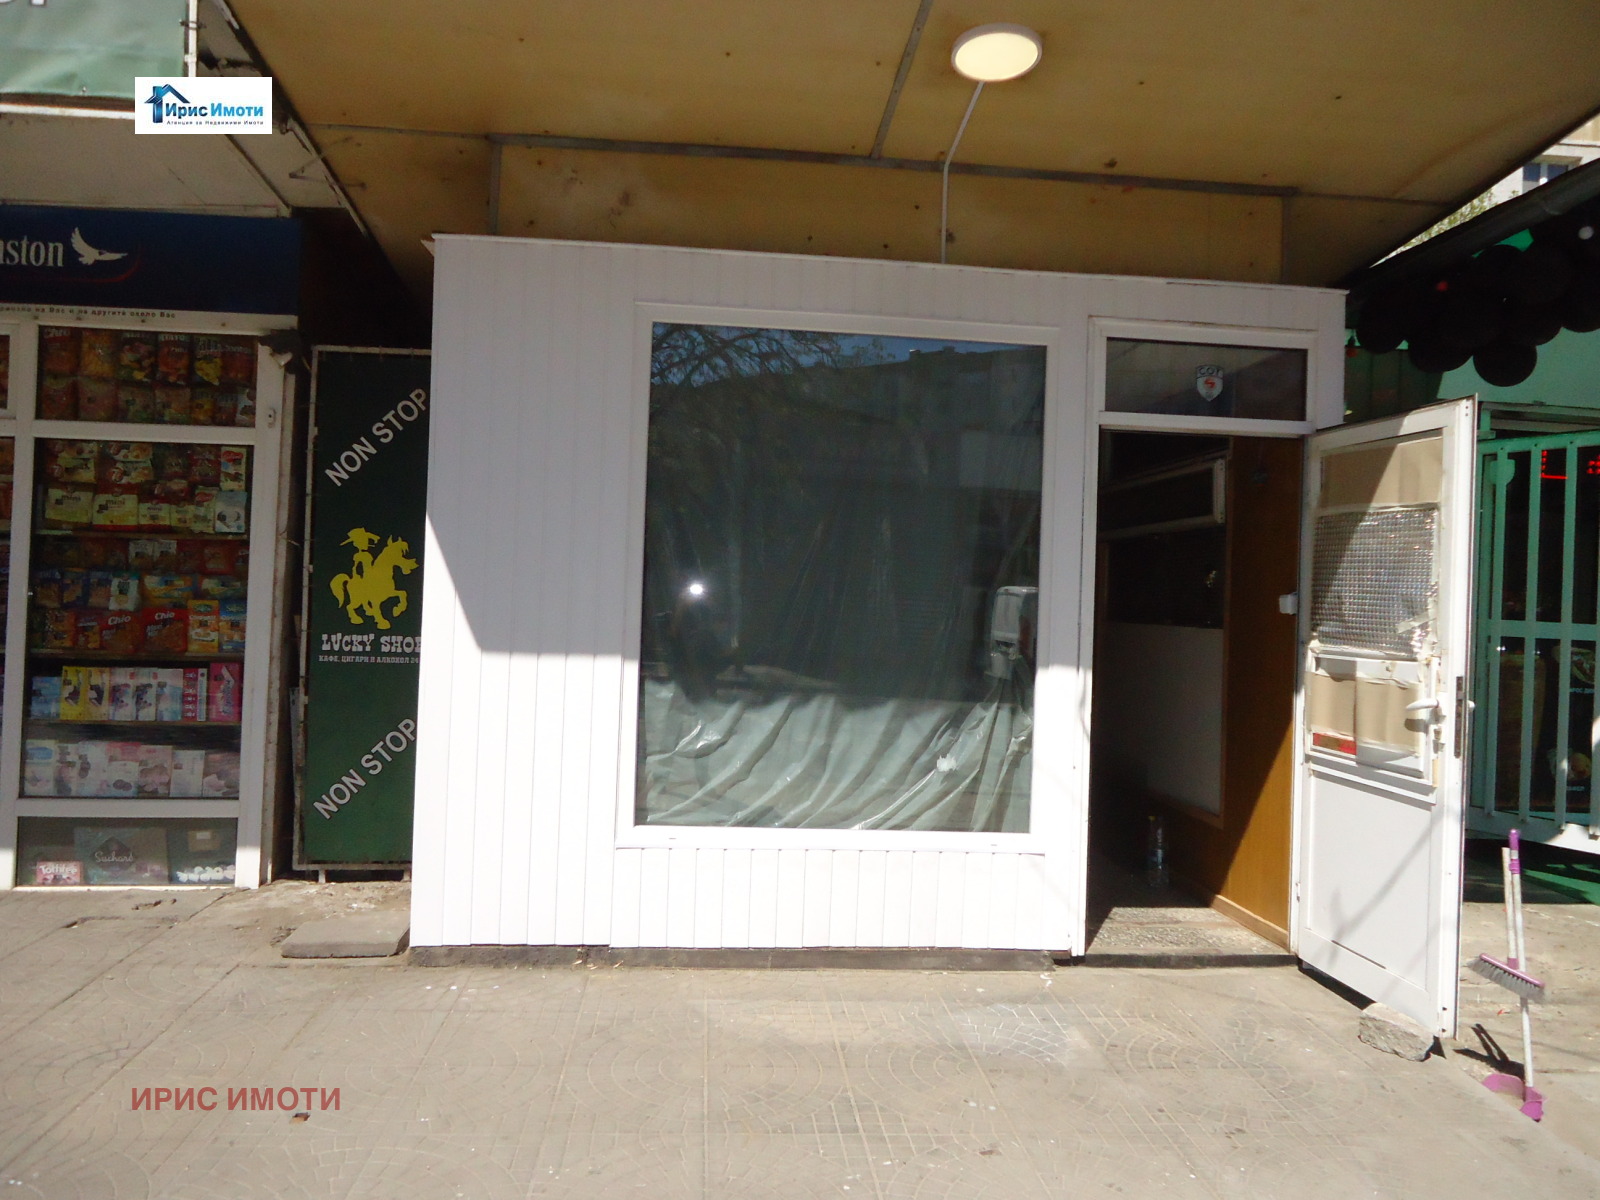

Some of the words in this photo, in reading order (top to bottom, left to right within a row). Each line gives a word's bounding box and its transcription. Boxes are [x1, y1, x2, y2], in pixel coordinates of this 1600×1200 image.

[324, 436, 378, 487] NON
[371, 388, 427, 444] STOP
[107, 614, 132, 626] Chio
[155, 610, 176, 621] Chio
[321, 632, 375, 652] LUCKY
[376, 656, 410, 664] АЛКОХОЛ
[313, 768, 367, 820] NON
[360, 718, 416, 776] STOP
[94, 851, 134, 863] Suchard
